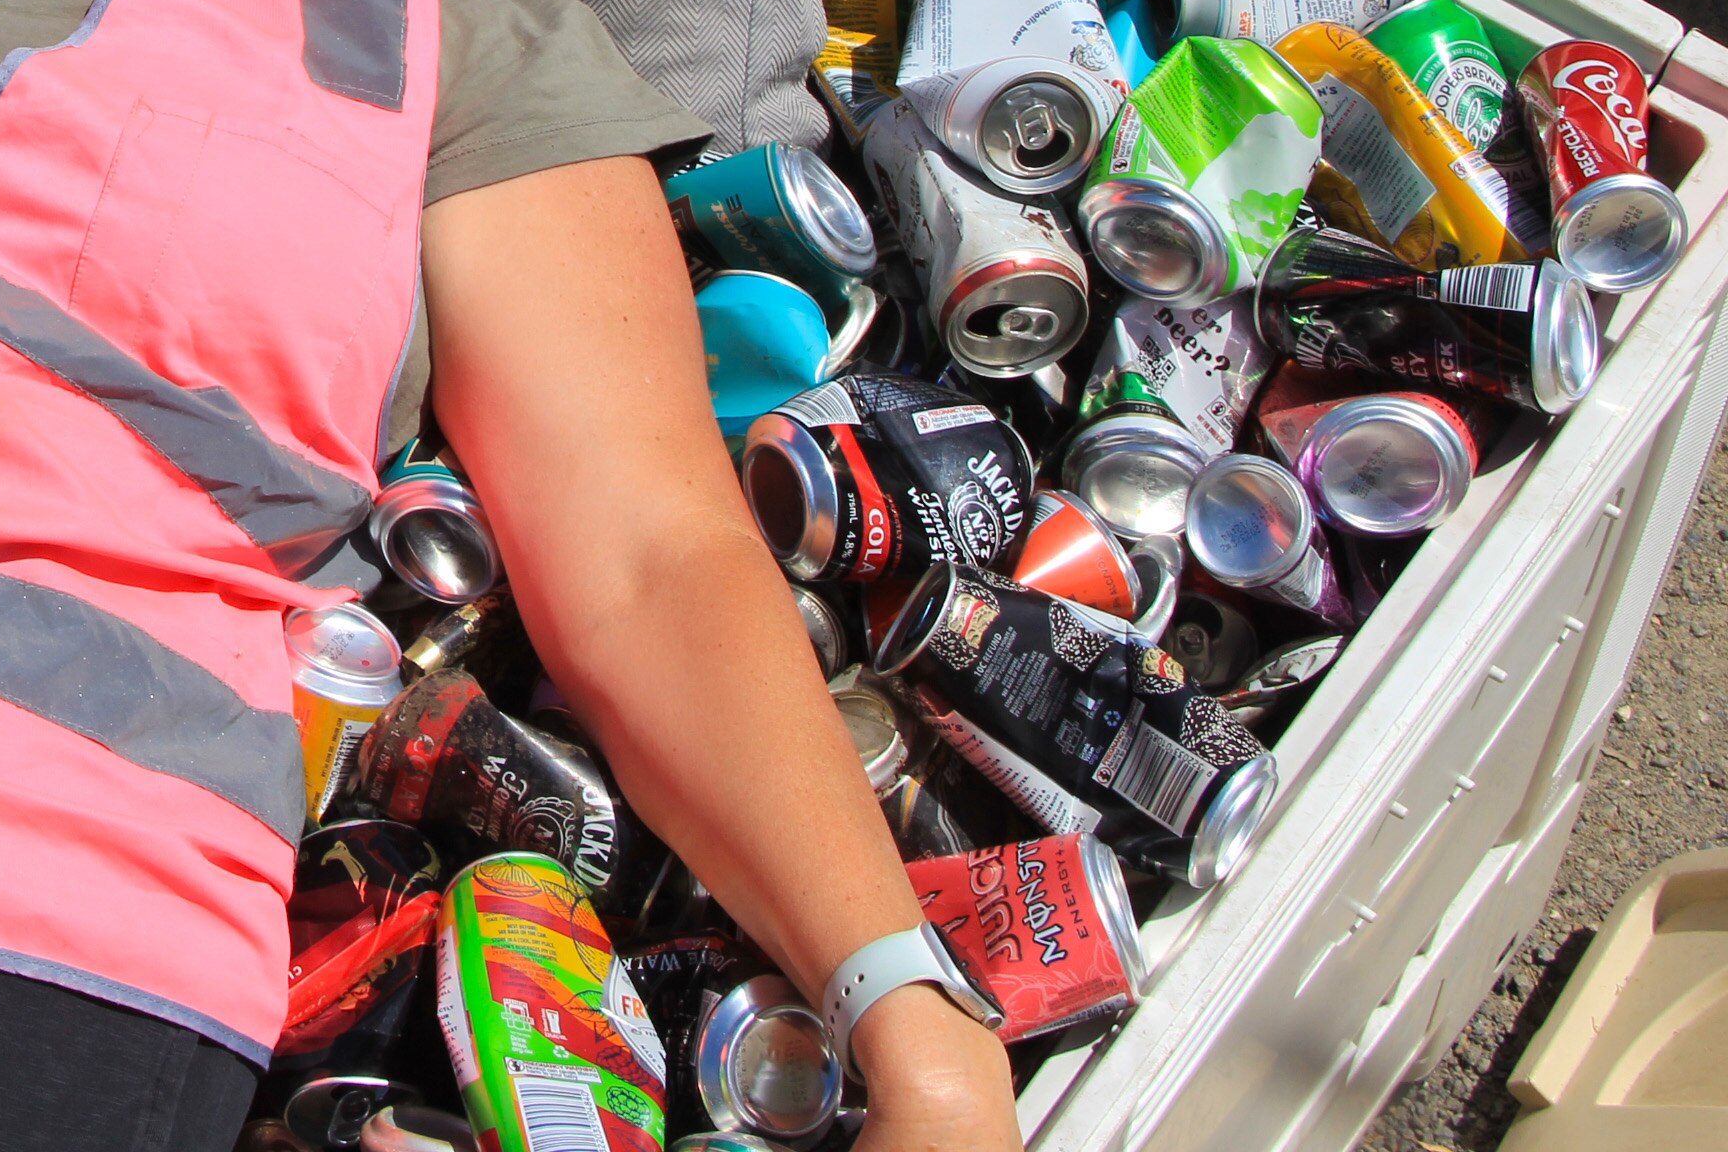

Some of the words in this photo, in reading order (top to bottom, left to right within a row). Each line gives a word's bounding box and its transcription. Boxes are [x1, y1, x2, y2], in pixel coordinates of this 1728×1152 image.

[1011, 24, 1028, 47] beer
[1556, 120, 1600, 178] RECYCLE
[927, 407, 963, 418] PREGNANCY
[1134, 404, 1164, 416] 375mL
[966, 448, 1021, 511] JACK
[846, 491, 859, 525] 375mL
[840, 530, 857, 559] 4.8%
[858, 507, 884, 574] COLA
[961, 517, 980, 558] BRAND
[986, 522, 996, 545] OLD
[973, 660, 987, 679] 10C
[981, 631, 1003, 664] REFUND
[1021, 670, 1037, 694] BEVERAGES
[1004, 693, 1015, 709] STORE
[1101, 728, 1123, 766] PREGNANCY
[510, 1035, 528, 1043] Drink
[523, 1061, 564, 1072] PREGNANCY
[564, 1064, 597, 1073] WARNING
